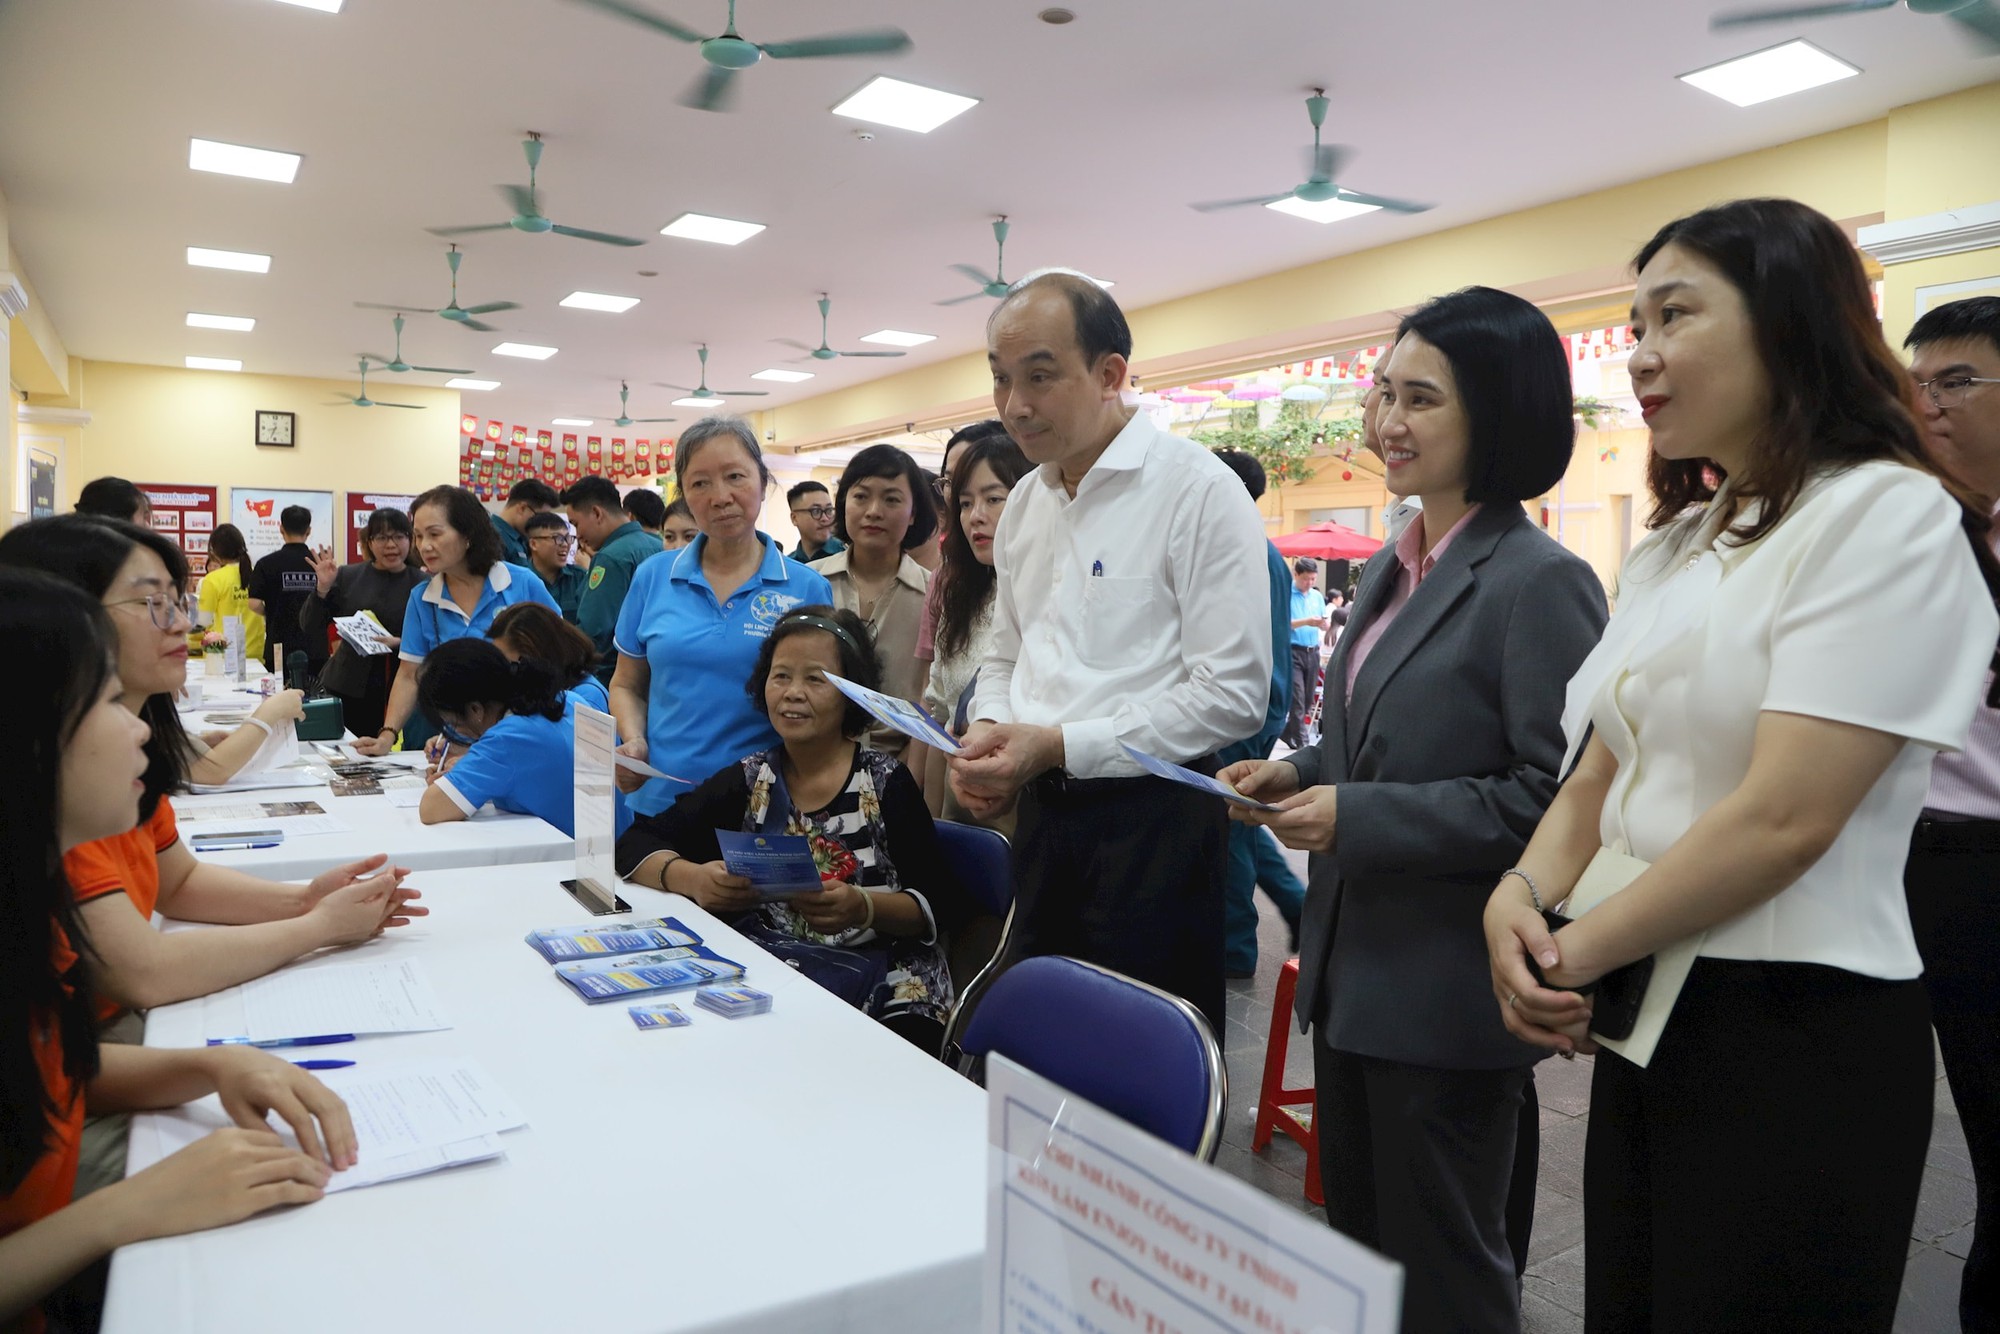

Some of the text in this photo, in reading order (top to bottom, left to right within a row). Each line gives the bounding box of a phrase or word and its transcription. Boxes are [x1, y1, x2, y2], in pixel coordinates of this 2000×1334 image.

[1142, 1198, 1198, 1244] CÔNG
[1205, 1231, 1230, 1262] TY
[1152, 1244, 1210, 1292] MART
